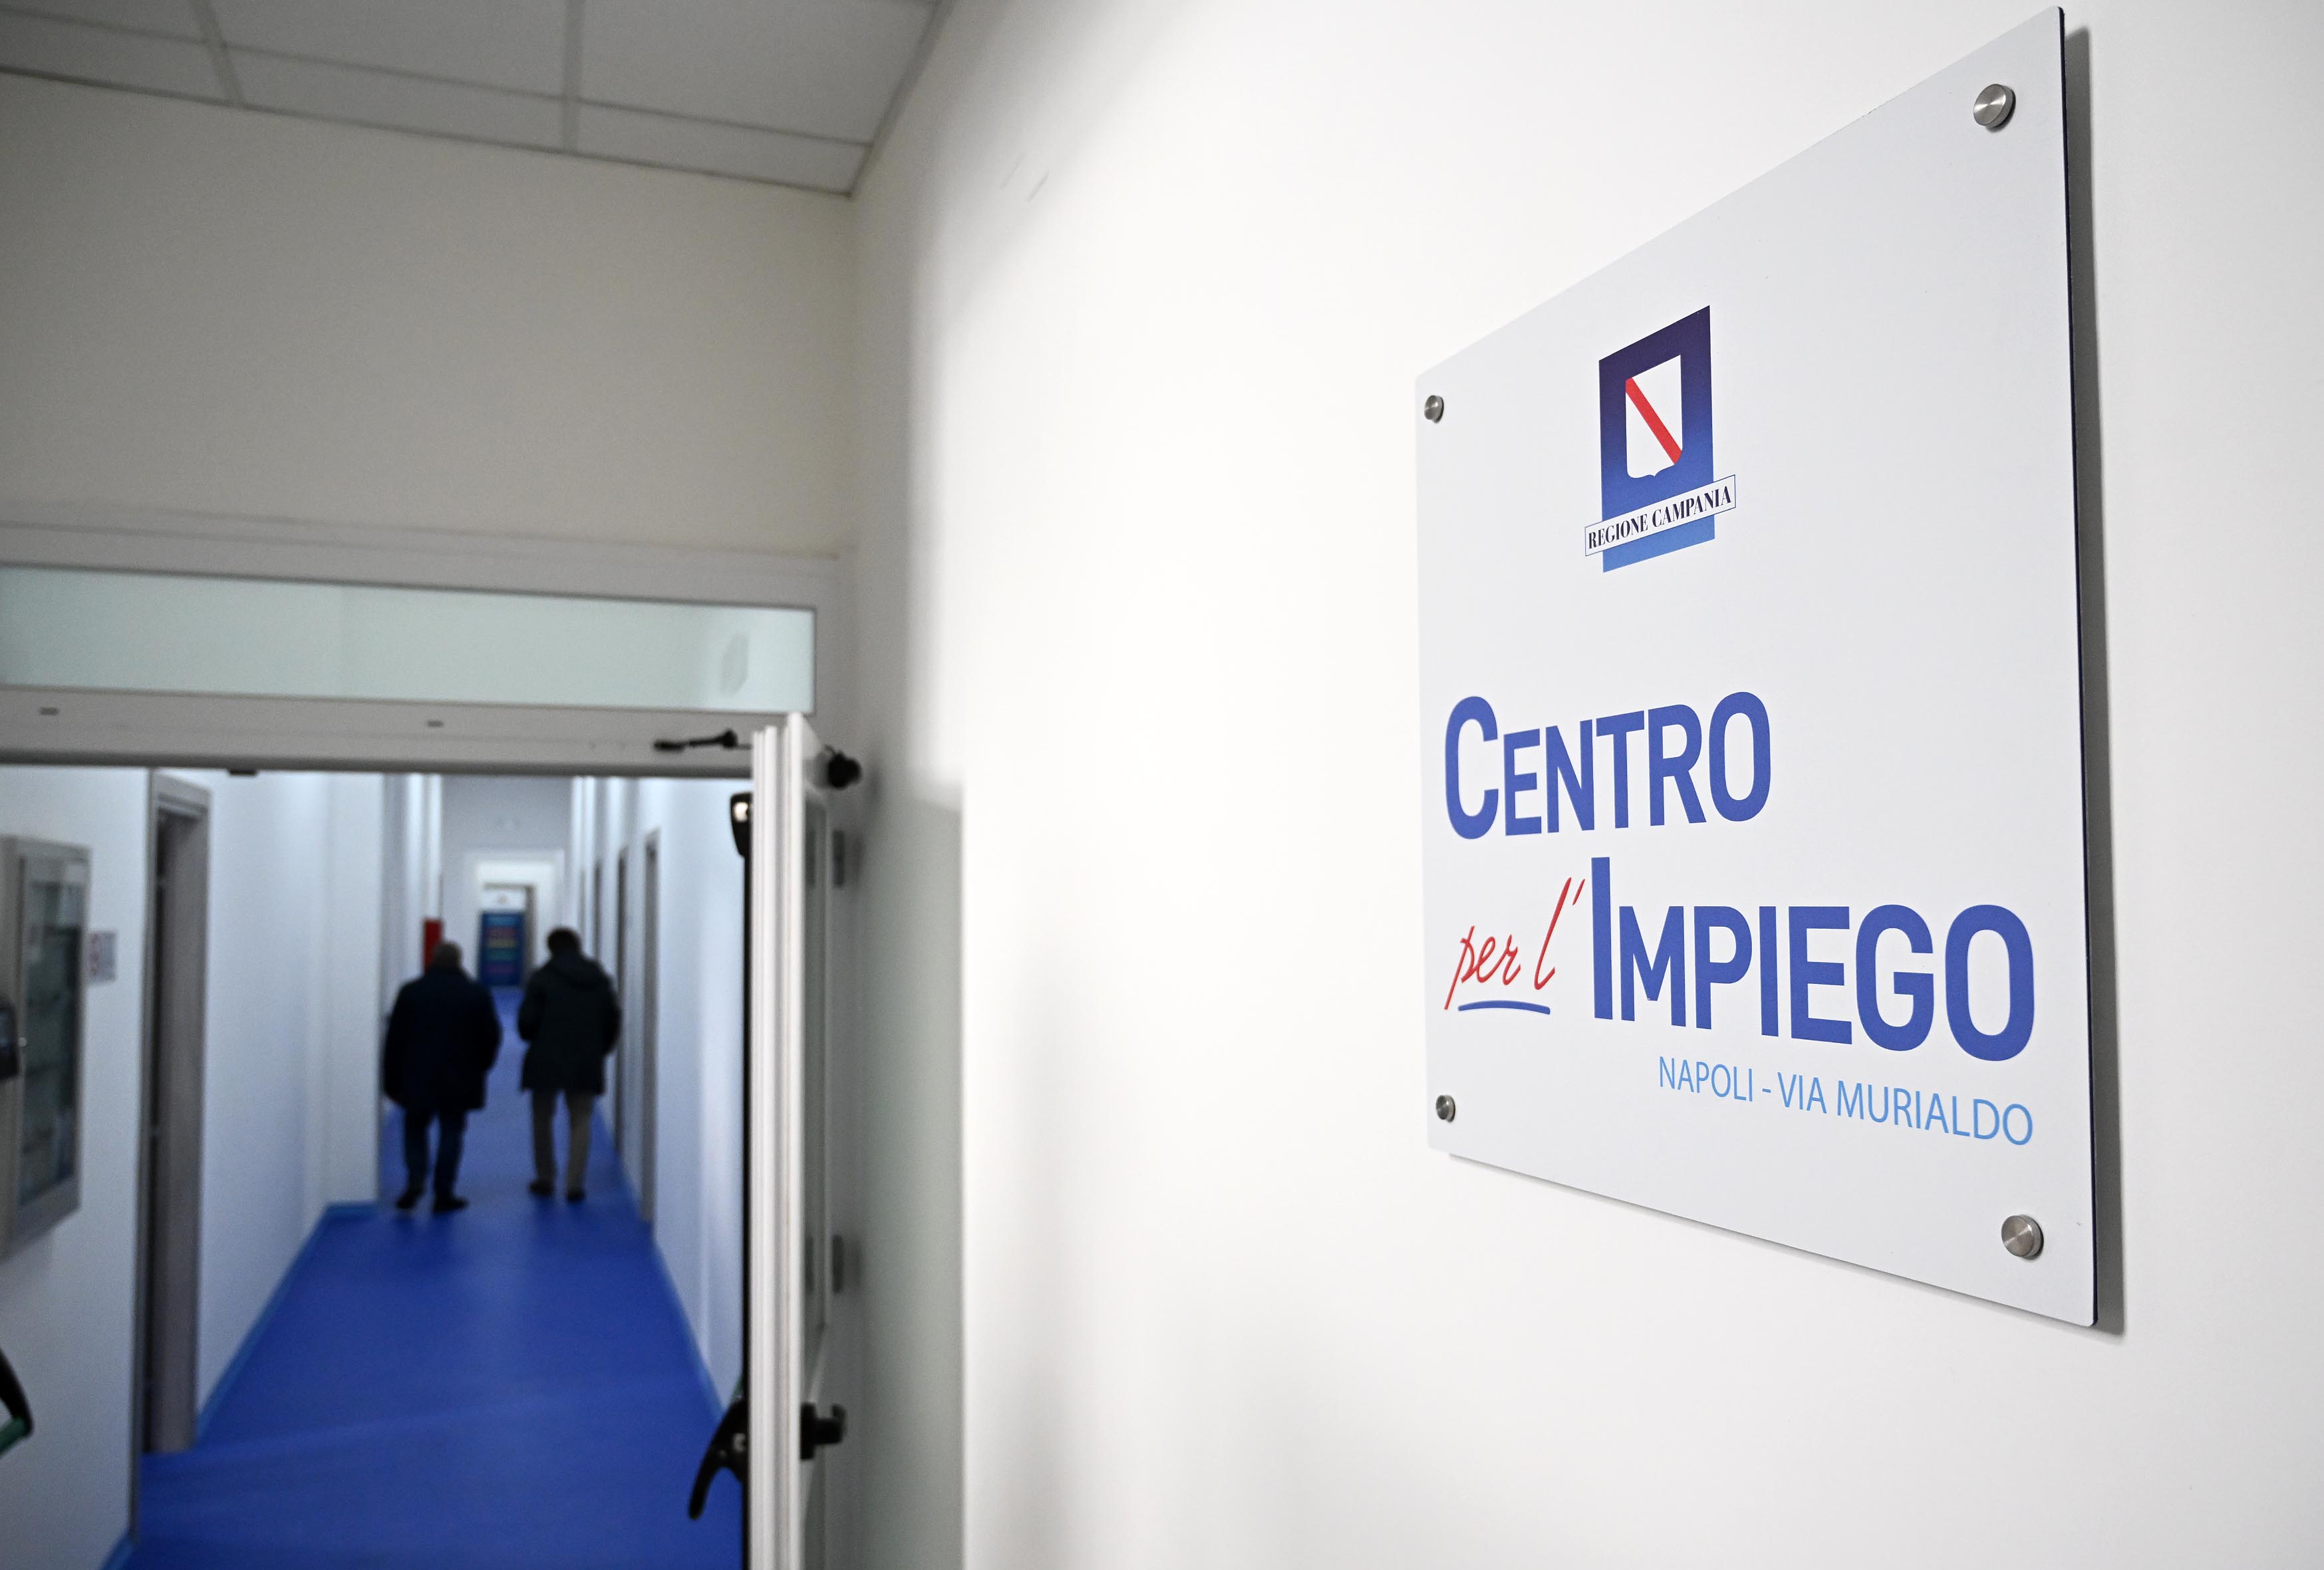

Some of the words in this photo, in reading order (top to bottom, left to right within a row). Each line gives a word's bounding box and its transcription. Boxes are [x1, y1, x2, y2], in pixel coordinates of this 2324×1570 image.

[1588, 514, 1648, 550] REGIONE
[1652, 486, 1732, 528] CAMPANIA
[1445, 691, 1771, 840] CENTRO
[1444, 925, 1522, 1011] per
[1591, 856, 2035, 1062] IMPIEGO
[1660, 1056, 1753, 1102] NAPOLI
[1777, 1072, 1828, 1114] VIA
[1836, 1080, 2033, 1146] MURIALDO
